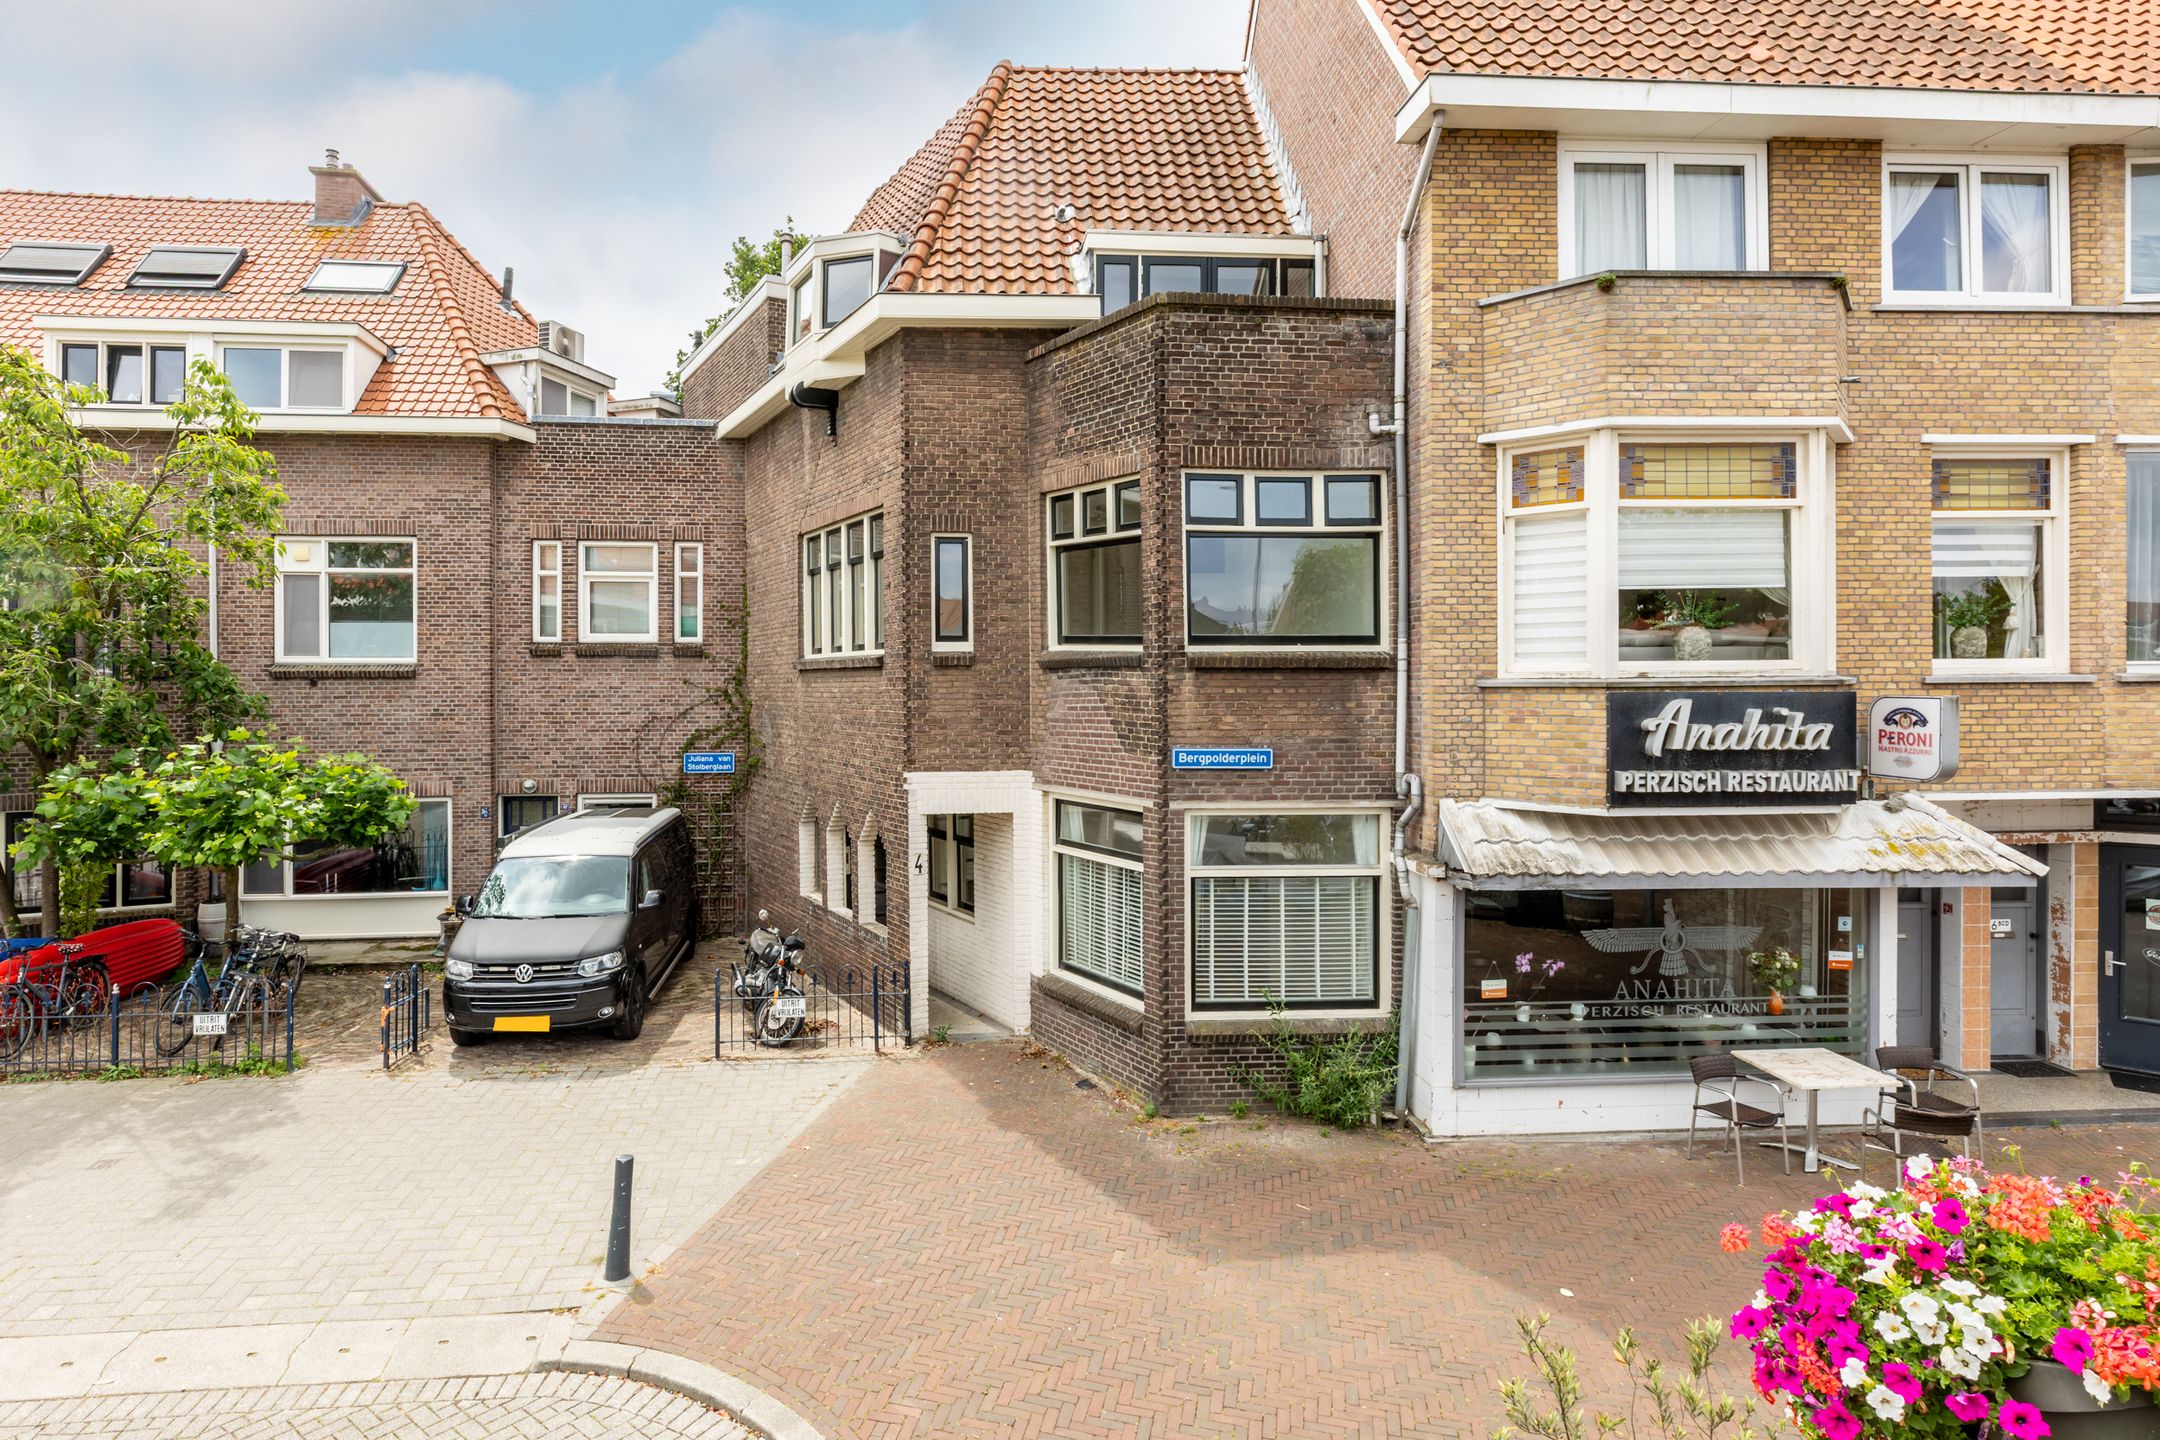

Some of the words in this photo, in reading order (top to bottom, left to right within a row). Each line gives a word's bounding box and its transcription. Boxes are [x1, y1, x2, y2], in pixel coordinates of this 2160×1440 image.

[1641, 698, 1834, 757] Anahita
[1878, 729, 1933, 748] PERONI
[1878, 745, 1903, 754] NASTRO
[1904, 747, 1933, 756] AZZURRO
[1178, 752, 1267, 765] Bergpolderplein
[687, 763, 731, 771] Stolberglaan
[1617, 770, 1721, 793] PERZISCH
[1724, 769, 1861, 793] RESTAURANT
[914, 853, 923, 874] 4
[1613, 978, 1737, 1000] ANAHITA
[781, 999, 800, 1007] UITRIT
[777, 1008, 805, 1016] VRIJLATEN
[1581, 1005, 1665, 1018] PERZISCH
[1676, 1002, 1769, 1015] RESTAURANT
[200, 1015, 220, 1024] UITRIT
[194, 1024, 225, 1033] VRIJLATEN
